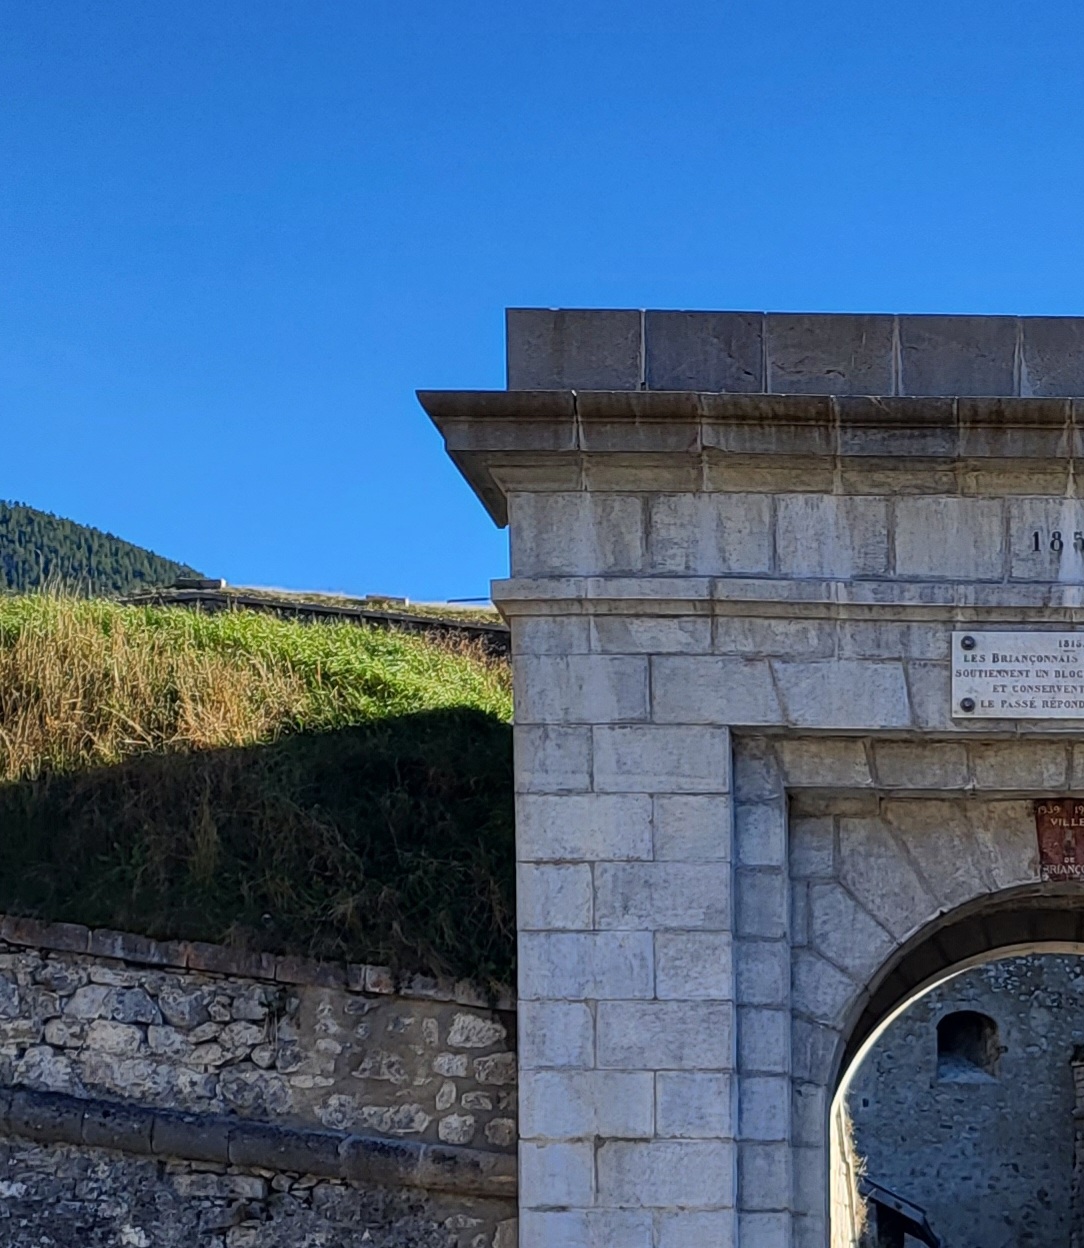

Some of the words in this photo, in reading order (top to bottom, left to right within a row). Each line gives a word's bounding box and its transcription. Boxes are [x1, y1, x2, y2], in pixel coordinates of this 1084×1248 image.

[963, 654, 986, 663] LES
[955, 669, 1031, 679] SOUTIENNENT
[1035, 669, 1049, 679] UN
[992, 685, 1007, 693] ET
[1012, 685, 1084, 694] CONSERVENT
[980, 699, 995, 708] LE
[1001, 697, 1037, 709] PASSÉ
[1038, 805, 1061, 814] 1939
